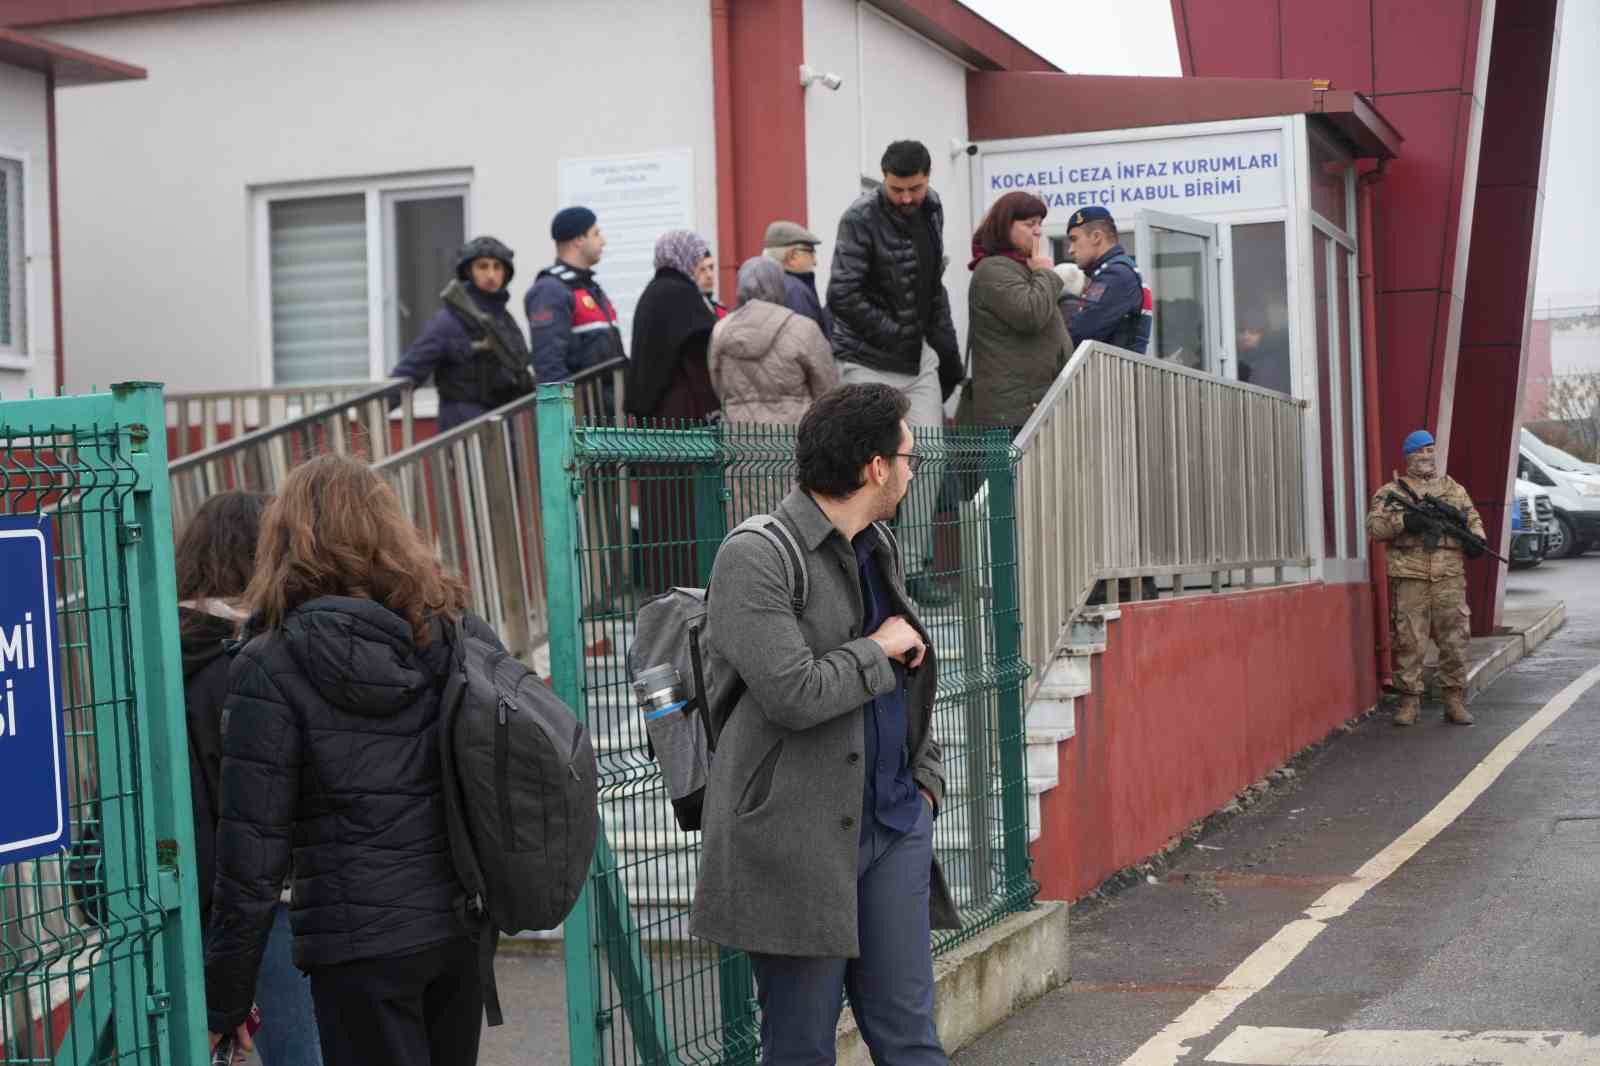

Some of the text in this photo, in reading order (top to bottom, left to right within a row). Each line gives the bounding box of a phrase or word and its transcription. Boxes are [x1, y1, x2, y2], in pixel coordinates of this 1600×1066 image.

[991, 153, 1278, 189] KOCAELİ CEZA İNFAZ KURUMLARI
[1039, 175, 1241, 208] YARETÇİ KABUL BİRİMİ
